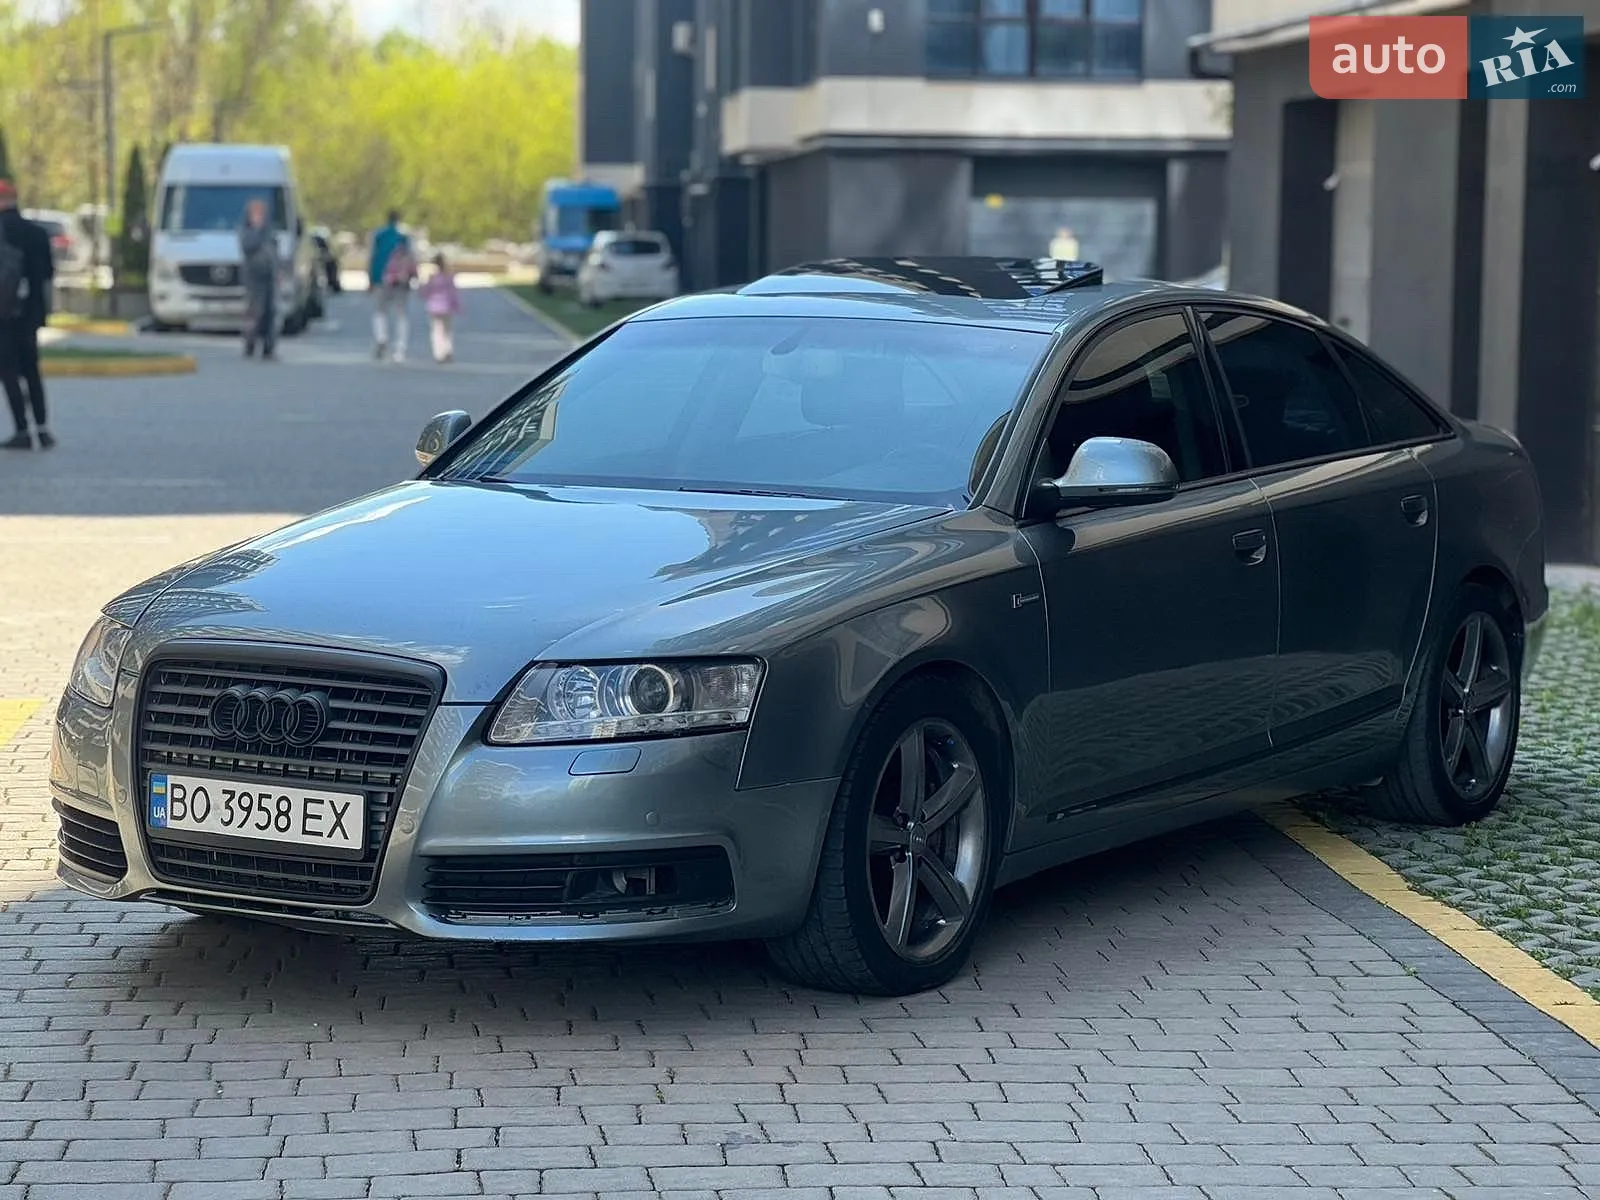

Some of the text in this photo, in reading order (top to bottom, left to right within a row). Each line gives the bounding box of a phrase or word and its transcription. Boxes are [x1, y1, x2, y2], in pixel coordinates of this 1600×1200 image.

[153, 806, 166, 818] UA
[169, 783, 351, 840] BO 3958 EX
